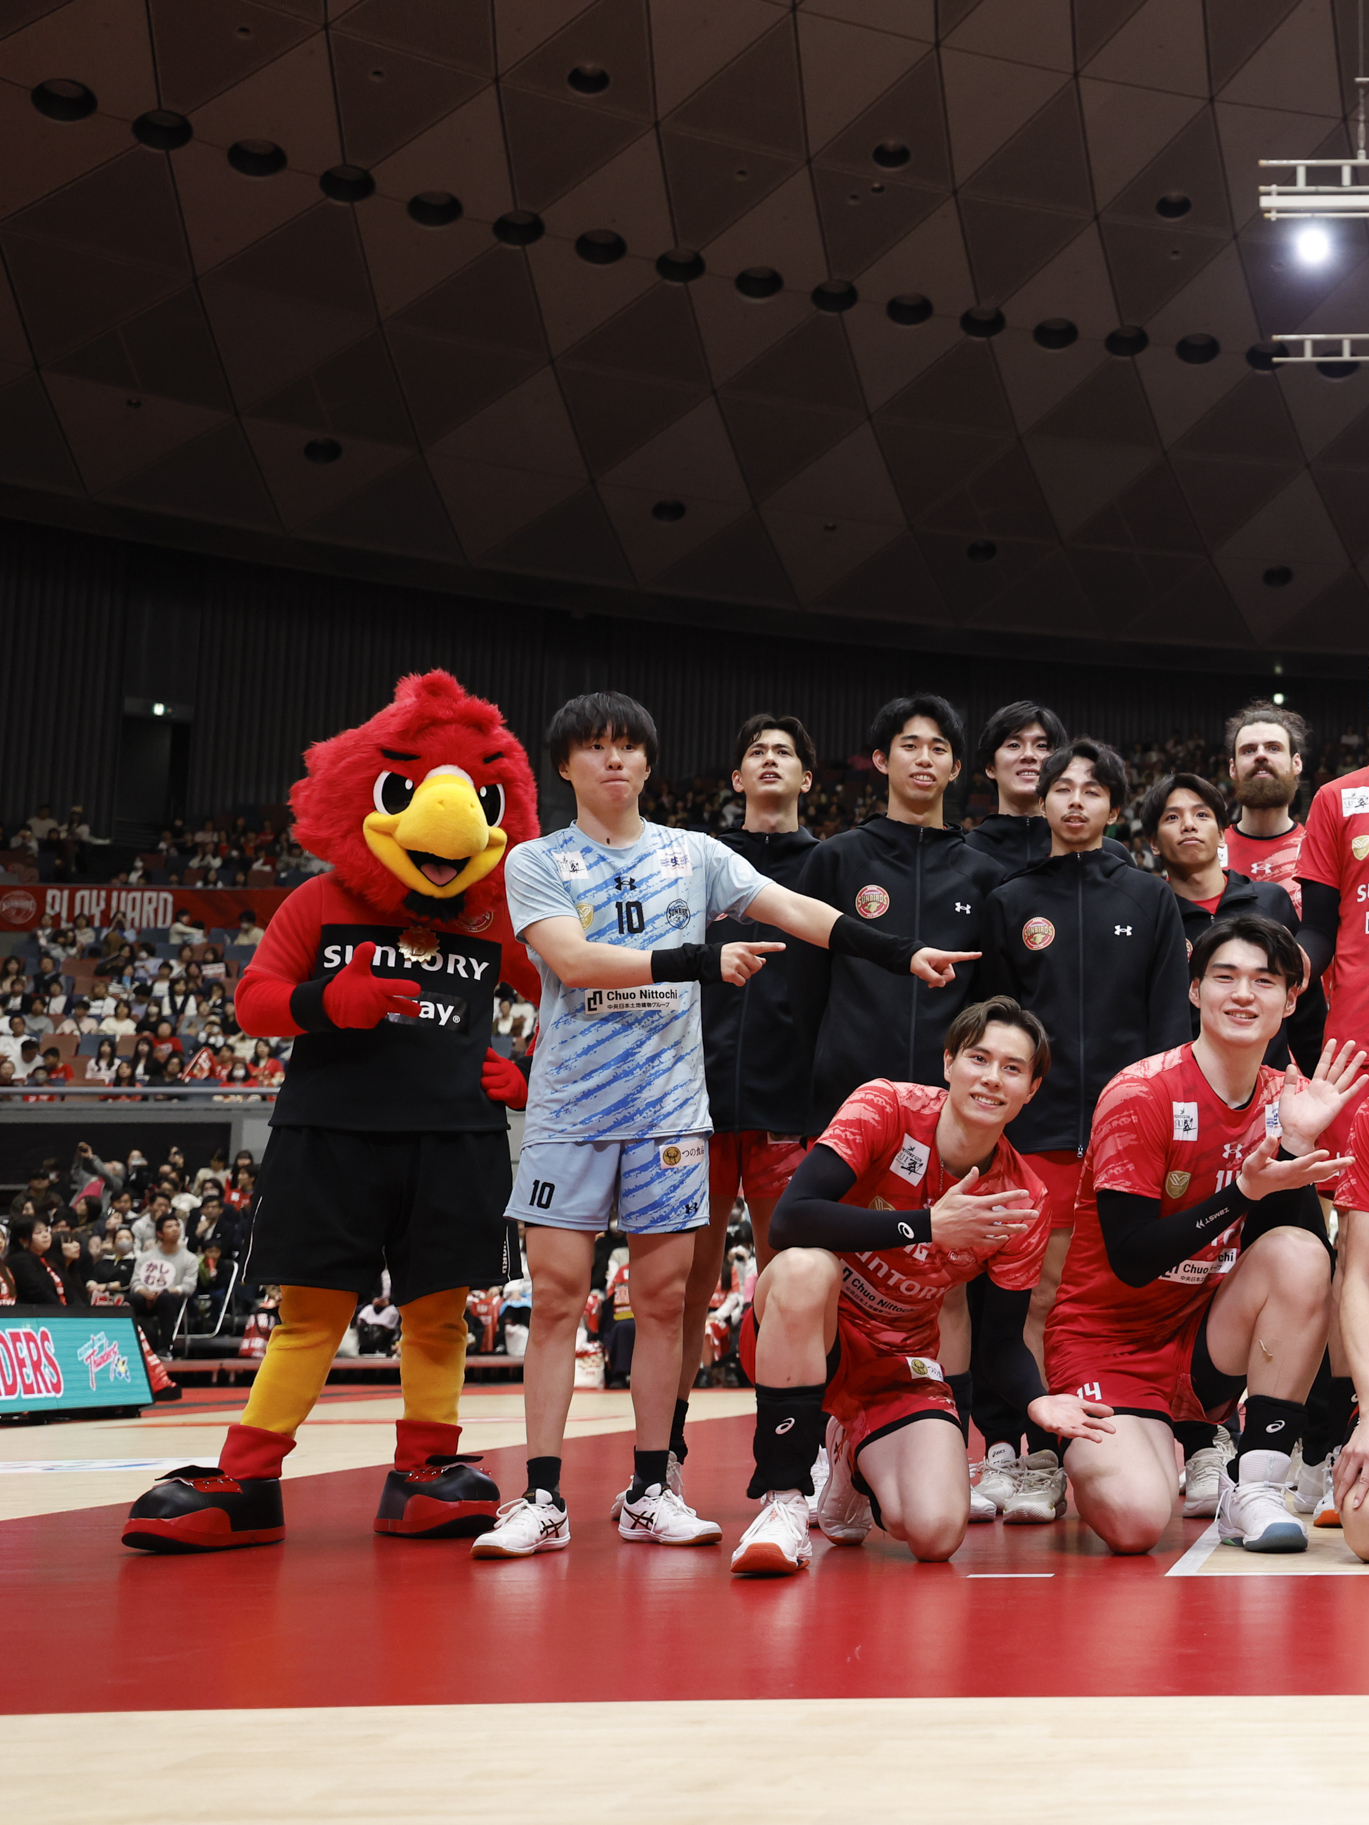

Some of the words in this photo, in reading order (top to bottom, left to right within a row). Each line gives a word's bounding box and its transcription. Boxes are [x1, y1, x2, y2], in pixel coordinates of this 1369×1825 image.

[46, 889, 106, 928] PLAY
[110, 890, 173, 928] HARD
[857, 894, 887, 908] SUNBIRDS
[615, 901, 645, 934] 10
[1024, 926, 1053, 940] SUNBIRDS
[606, 990, 636, 1001] Chuo
[639, 989, 678, 1000] Nittochi
[529, 1179, 555, 1210] 10
[1183, 1263, 1209, 1275] Chuo
[851, 1278, 876, 1302] Chuo
[1077, 1382, 1102, 1401] 14
